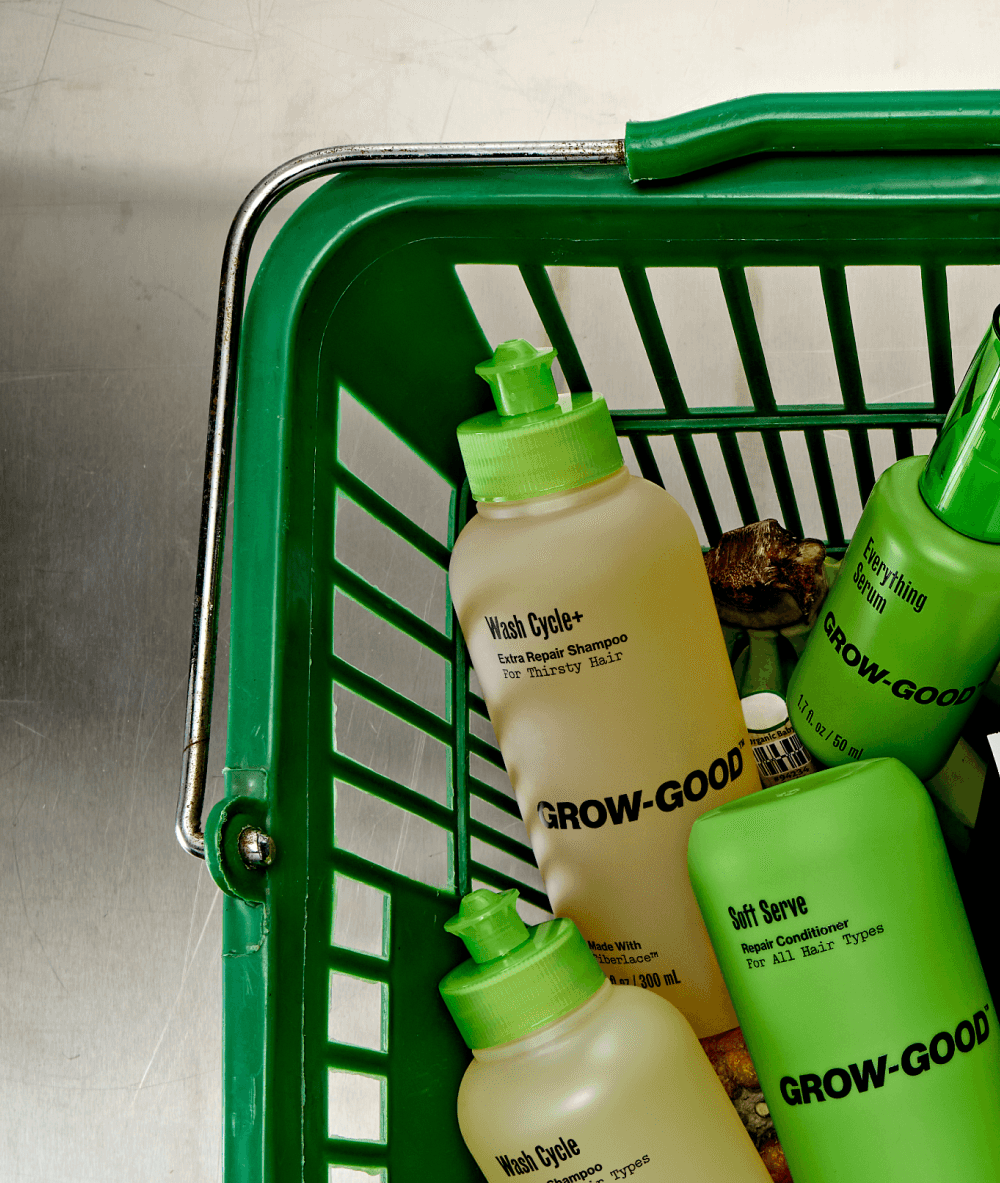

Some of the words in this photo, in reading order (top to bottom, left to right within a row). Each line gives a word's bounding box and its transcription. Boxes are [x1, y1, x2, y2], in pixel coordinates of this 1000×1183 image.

[852, 561, 887, 614] Serum
[862, 536, 928, 613] Everything
[483, 614, 527, 640] Wash
[526, 607, 584, 641] Cycle+
[497, 653, 526, 664] Extra
[524, 647, 565, 663] Repair
[566, 633, 628, 656] Shampoo
[502, 668, 521, 679] For
[526, 661, 582, 678] Thirsty
[588, 650, 623, 668] Hair
[749, 731, 776, 744] rganic
[797, 693, 809, 713] 1.7
[805, 709, 814, 726] fl.
[814, 721, 826, 737] oz
[832, 733, 848, 752] 50
[847, 746, 864, 761] ml
[727, 903, 759, 931] Soft
[758, 895, 808, 924] Serve
[586, 939, 614, 952] Made
[613, 940, 642, 951] With
[740, 938, 774, 954] Repair
[775, 919, 849, 947] Conditioner
[746, 958, 766, 969] For
[772, 949, 795, 965] All
[800, 940, 835, 957] Hair
[841, 924, 884, 945] Types
[494, 1150, 539, 1177] Wash
[534, 1136, 581, 1169] Cycle
[609, 1154, 650, 1181] Types
